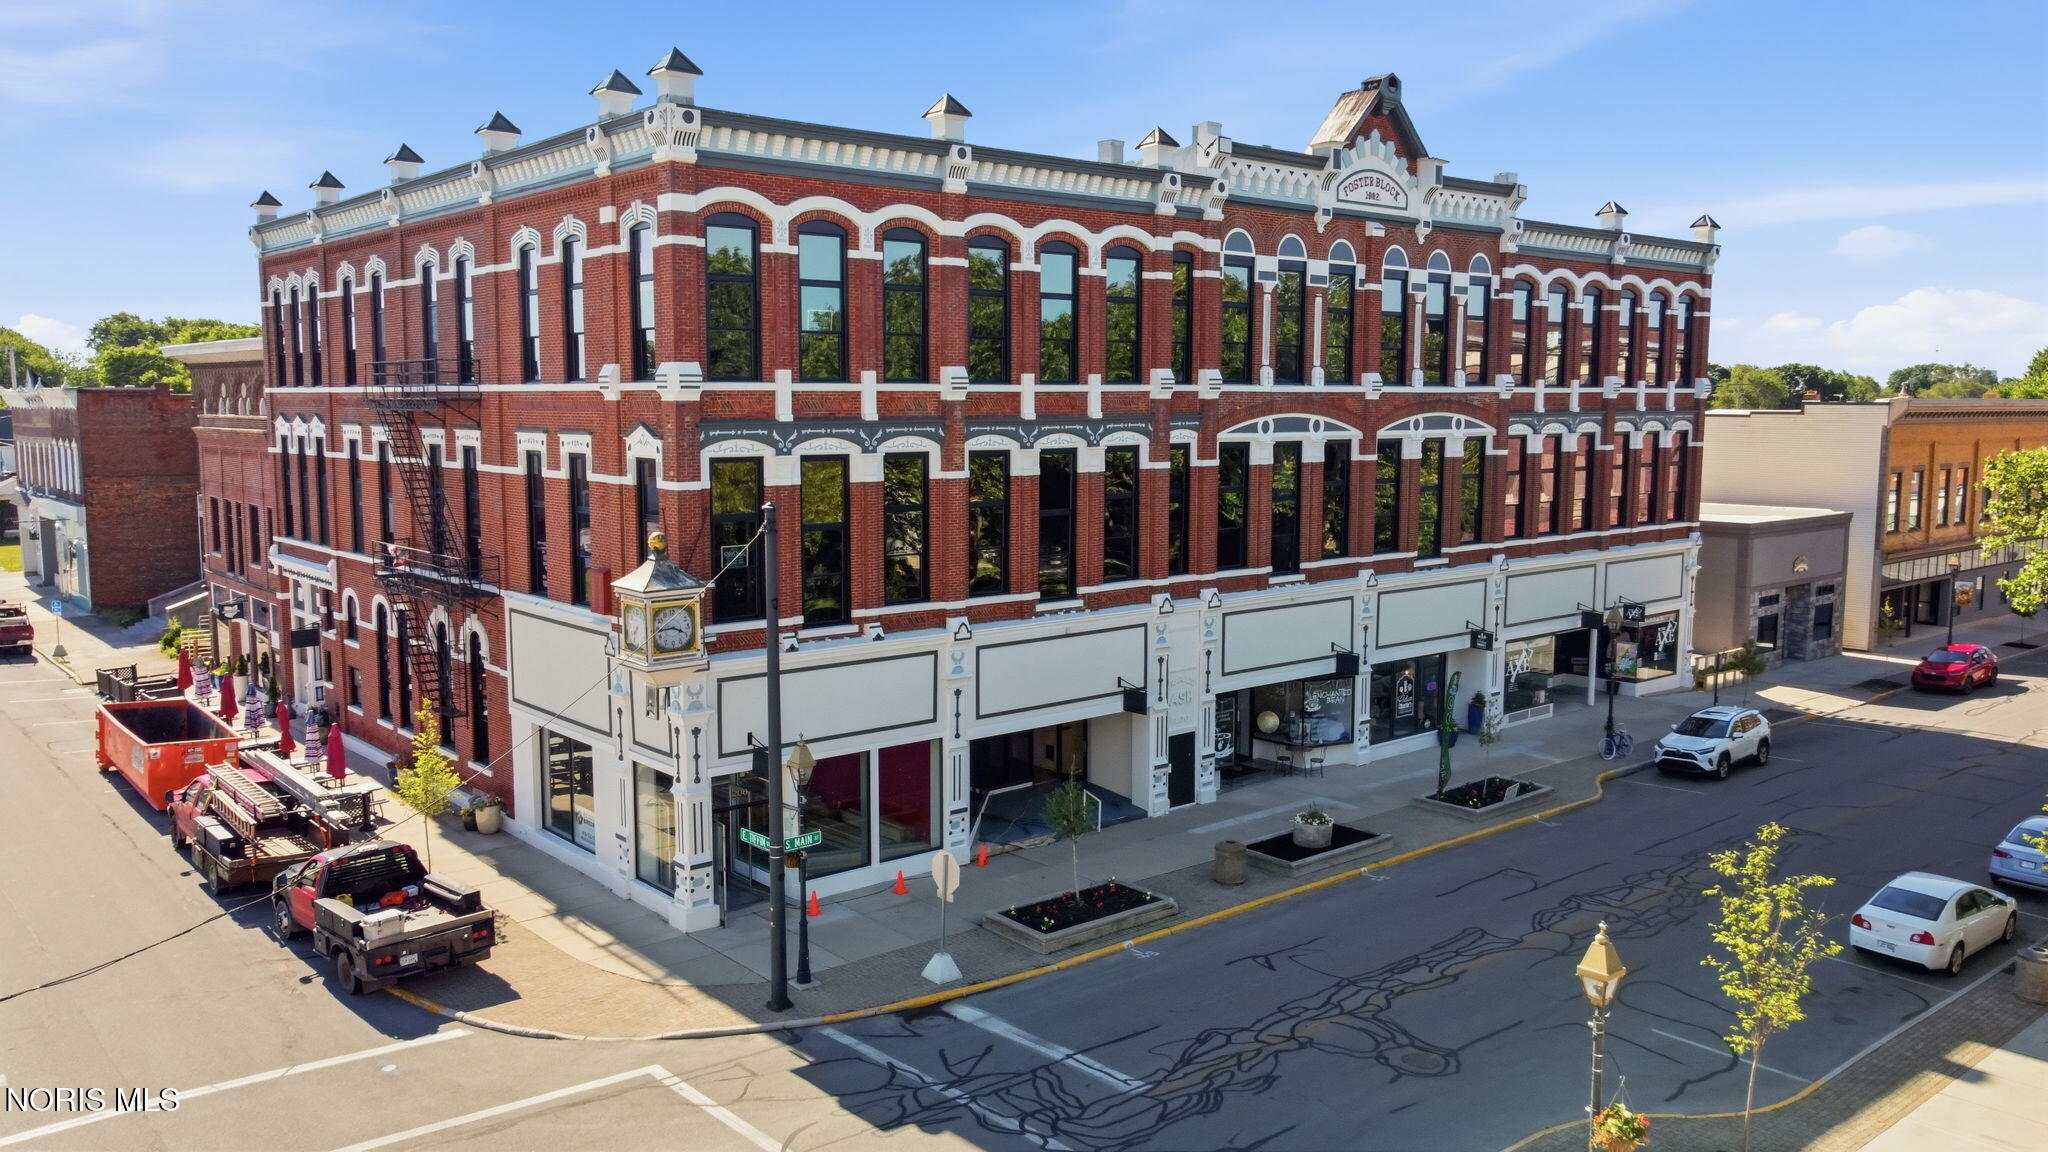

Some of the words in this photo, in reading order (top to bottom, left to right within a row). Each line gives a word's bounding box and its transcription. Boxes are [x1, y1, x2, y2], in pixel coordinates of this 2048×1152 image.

[1343, 176, 1374, 197] FOSTER
[1312, 688, 1352, 700] ENCHANTED
[742, 830, 746, 840] E
[749, 832, 766, 847] TIFFIN
[785, 840, 790, 849] S
[795, 835, 813, 848] MAIN
